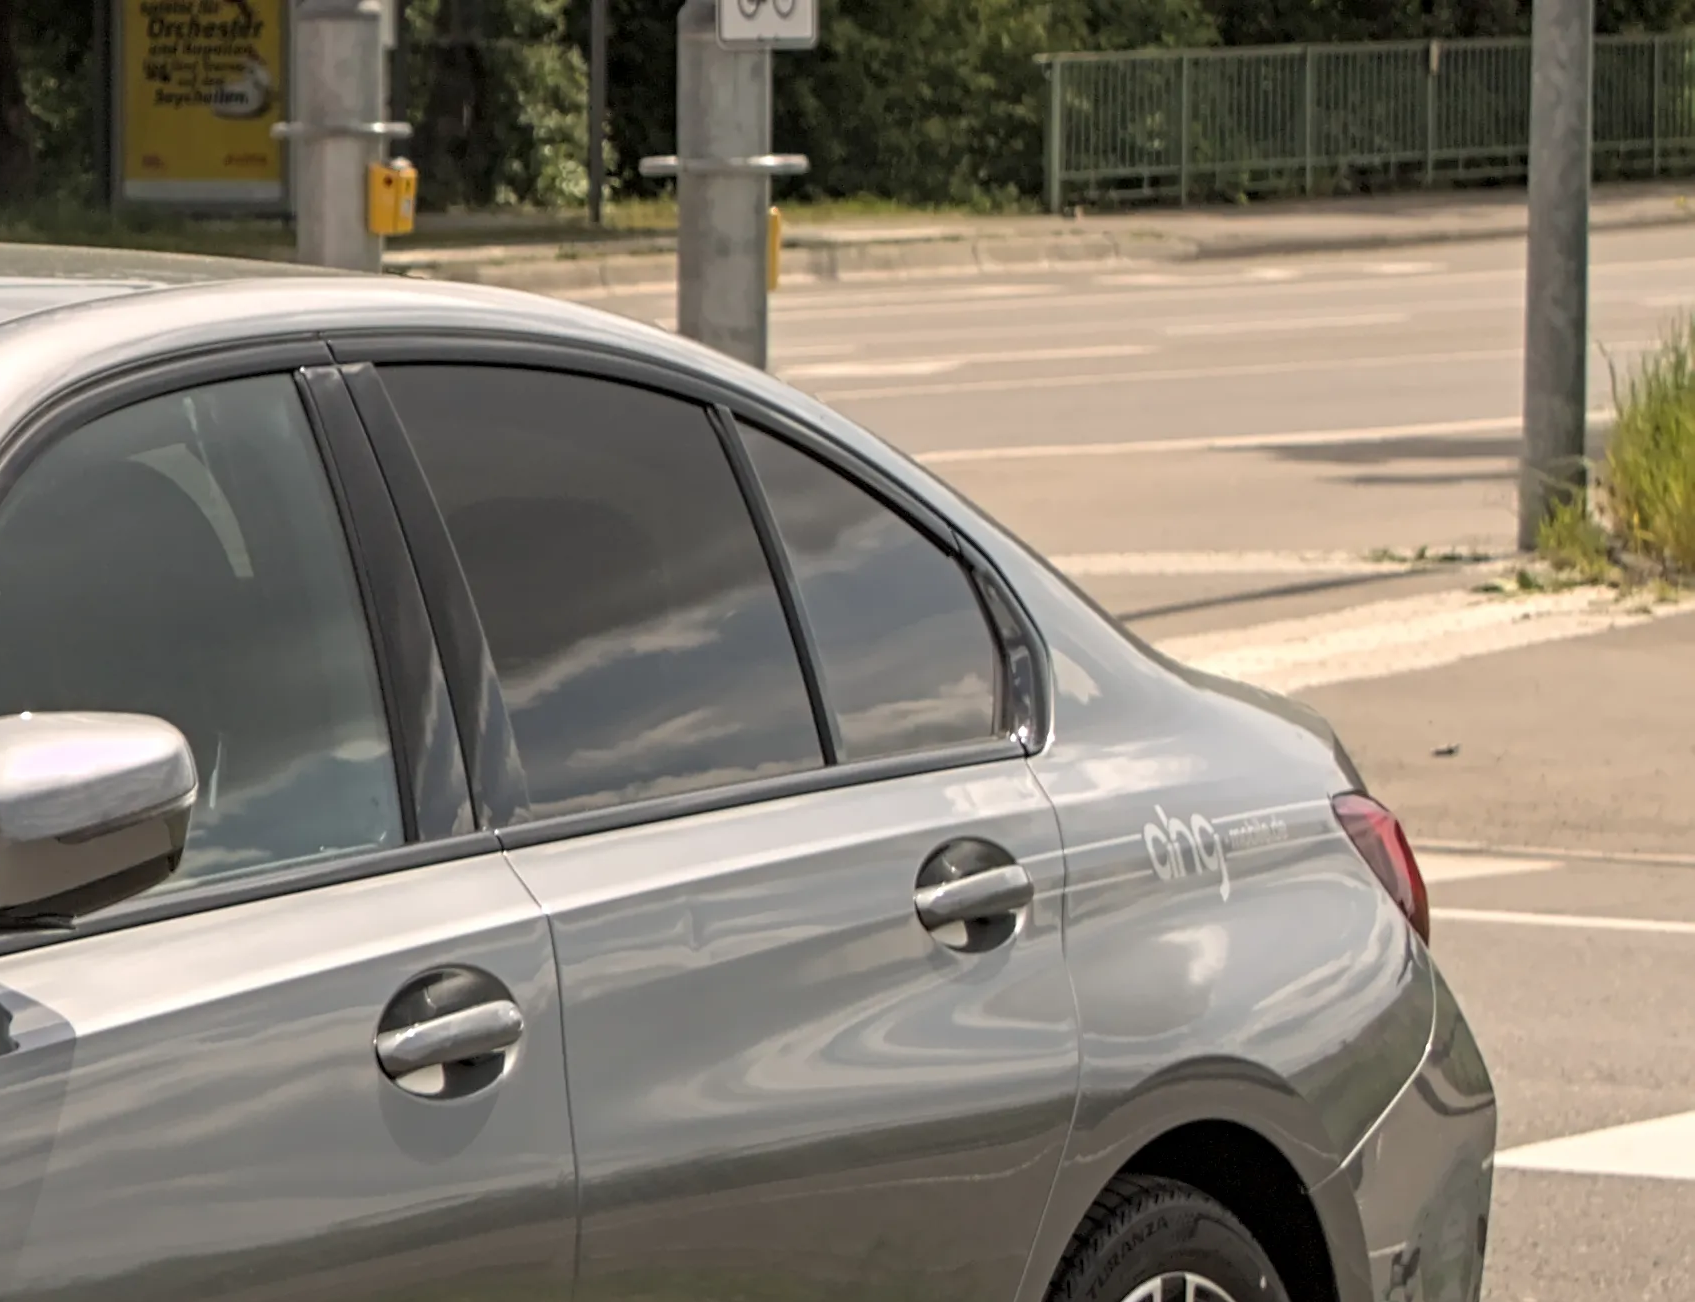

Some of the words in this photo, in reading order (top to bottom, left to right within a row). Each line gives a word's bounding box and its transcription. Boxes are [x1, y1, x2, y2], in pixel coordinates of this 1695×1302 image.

[147, 15, 265, 39] Orchester
[1141, 804, 1231, 903] ahg
[1085, 1215, 1170, 1300] TURANZA
